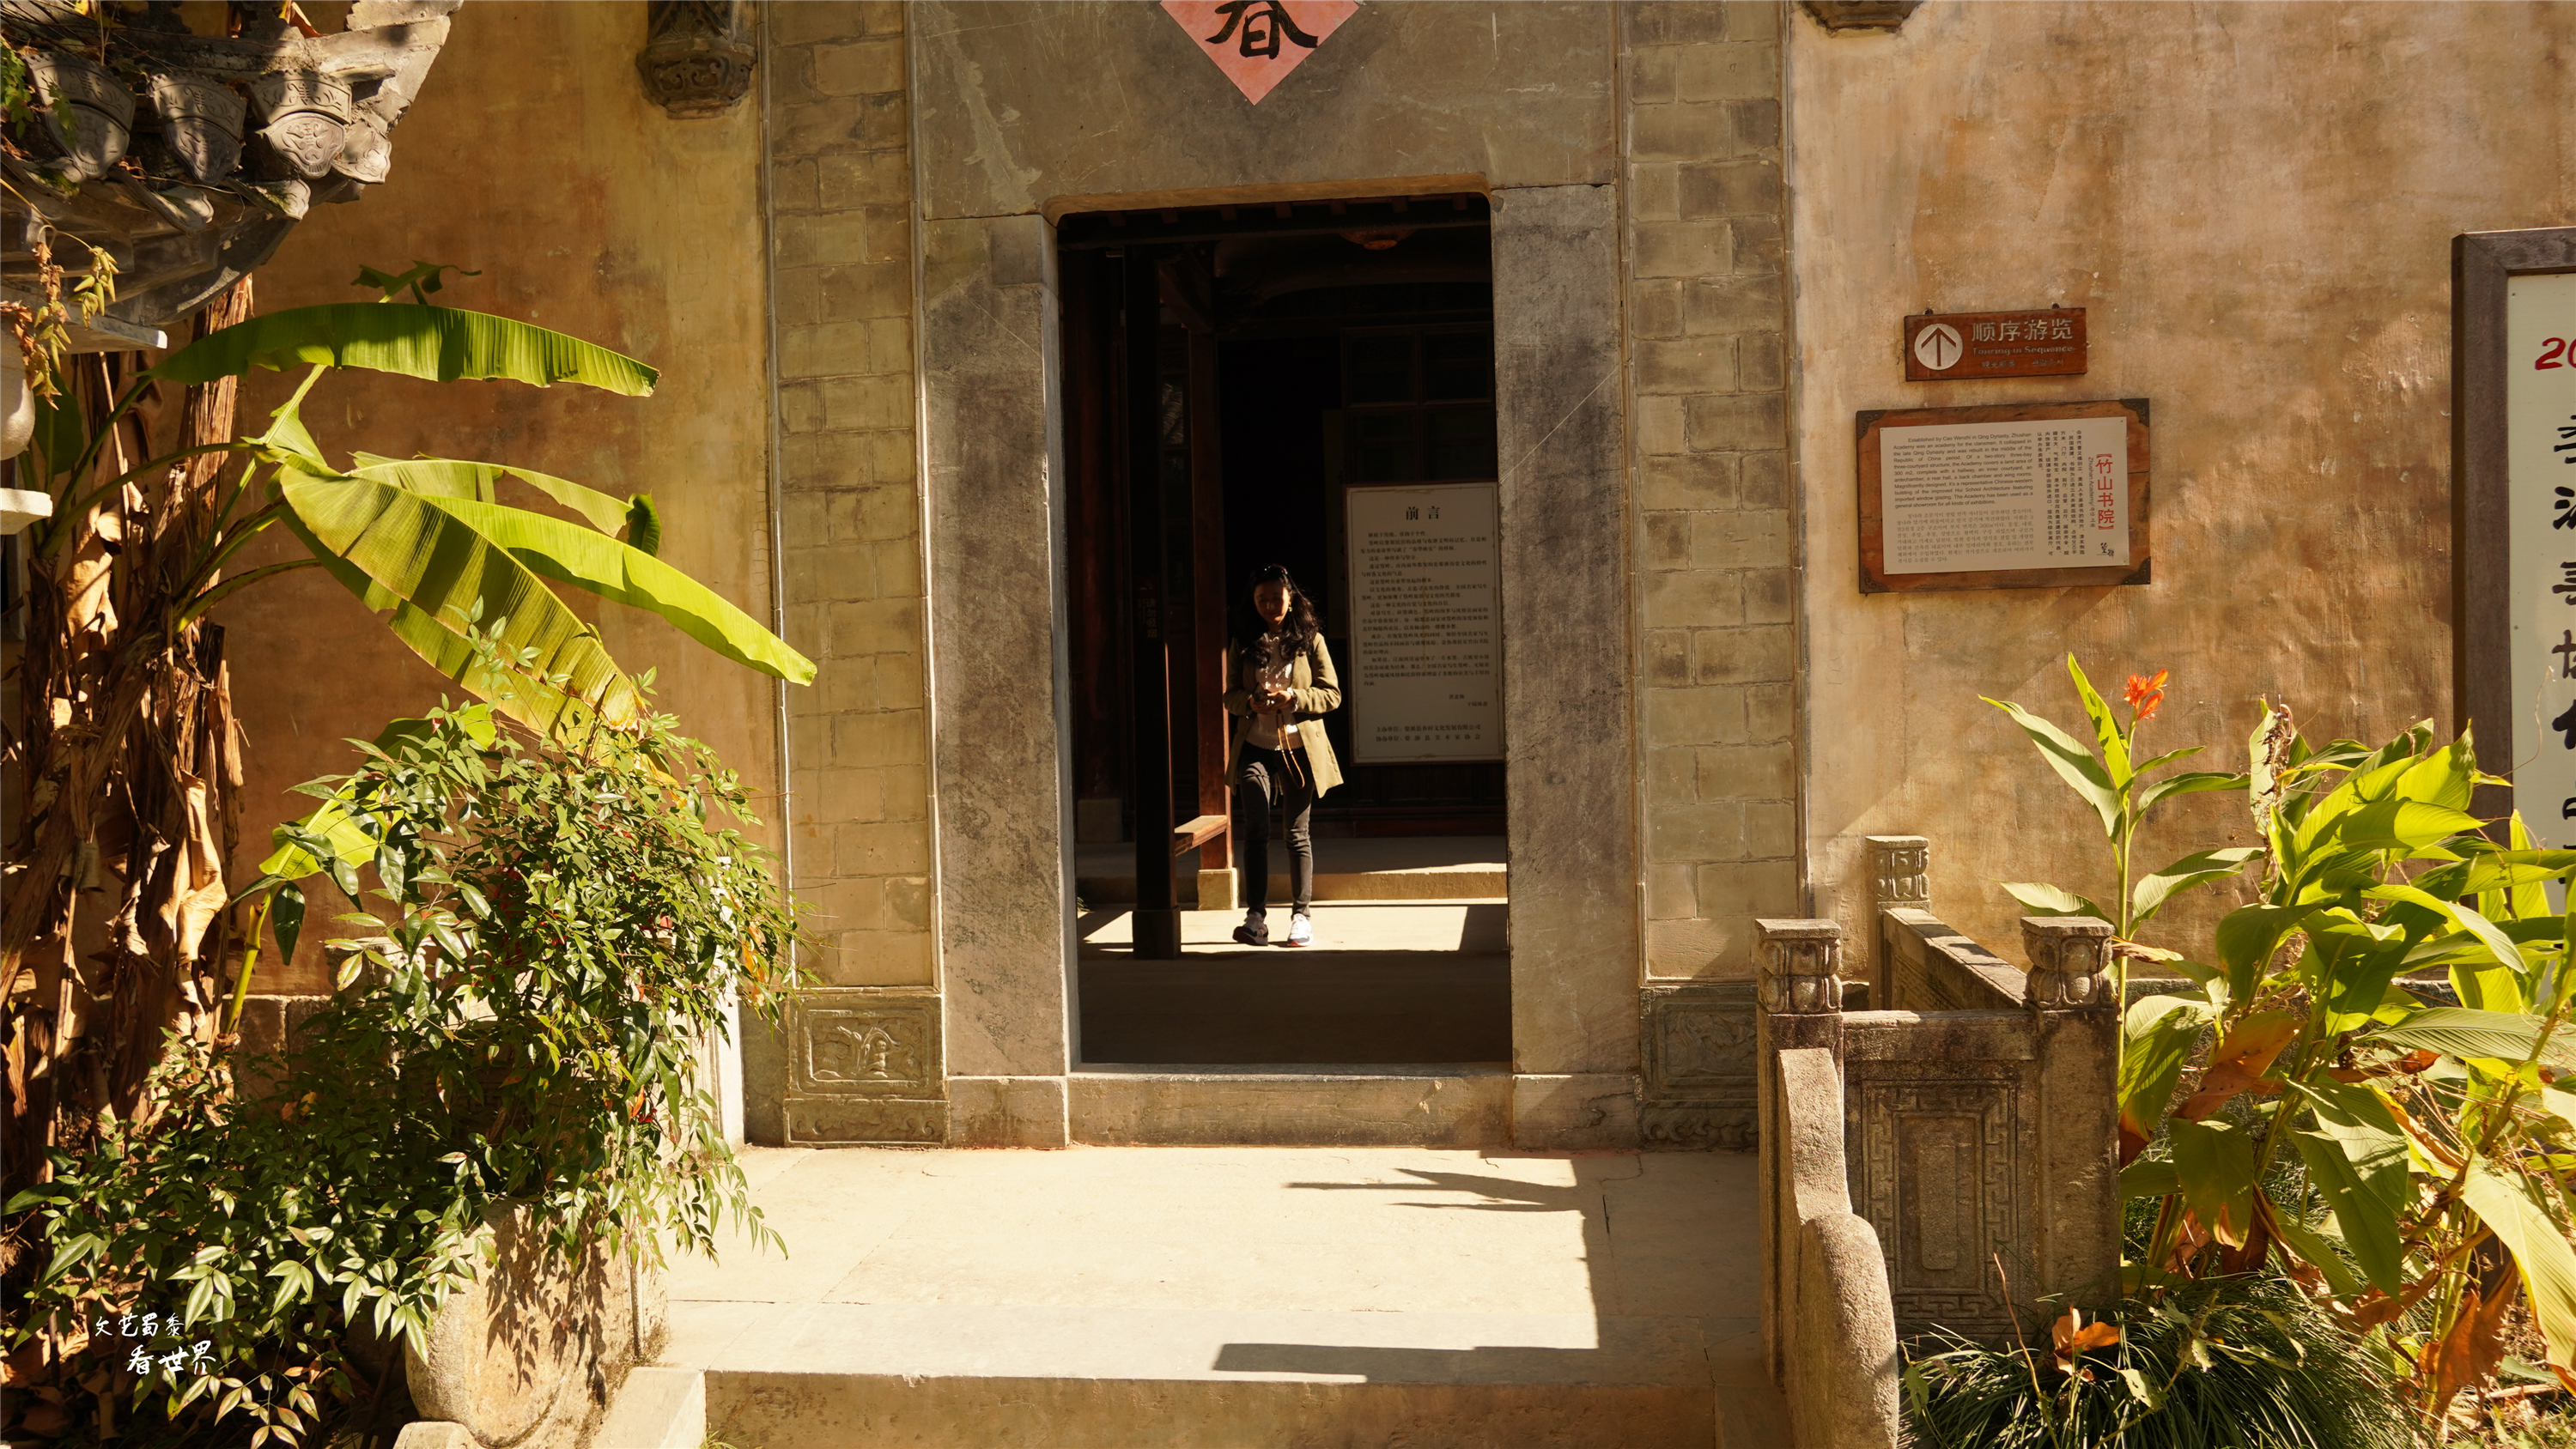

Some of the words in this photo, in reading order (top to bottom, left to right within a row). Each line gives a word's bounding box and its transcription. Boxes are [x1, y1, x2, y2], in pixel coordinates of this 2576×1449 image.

[1971, 318, 2074, 342] 顺序游览
[1972, 347, 2011, 357] Touring
[2024, 345, 2074, 354] Sequence
[1406, 506, 1441, 520] 前言
[1145, 598, 1157, 639] 请勿吸烟
